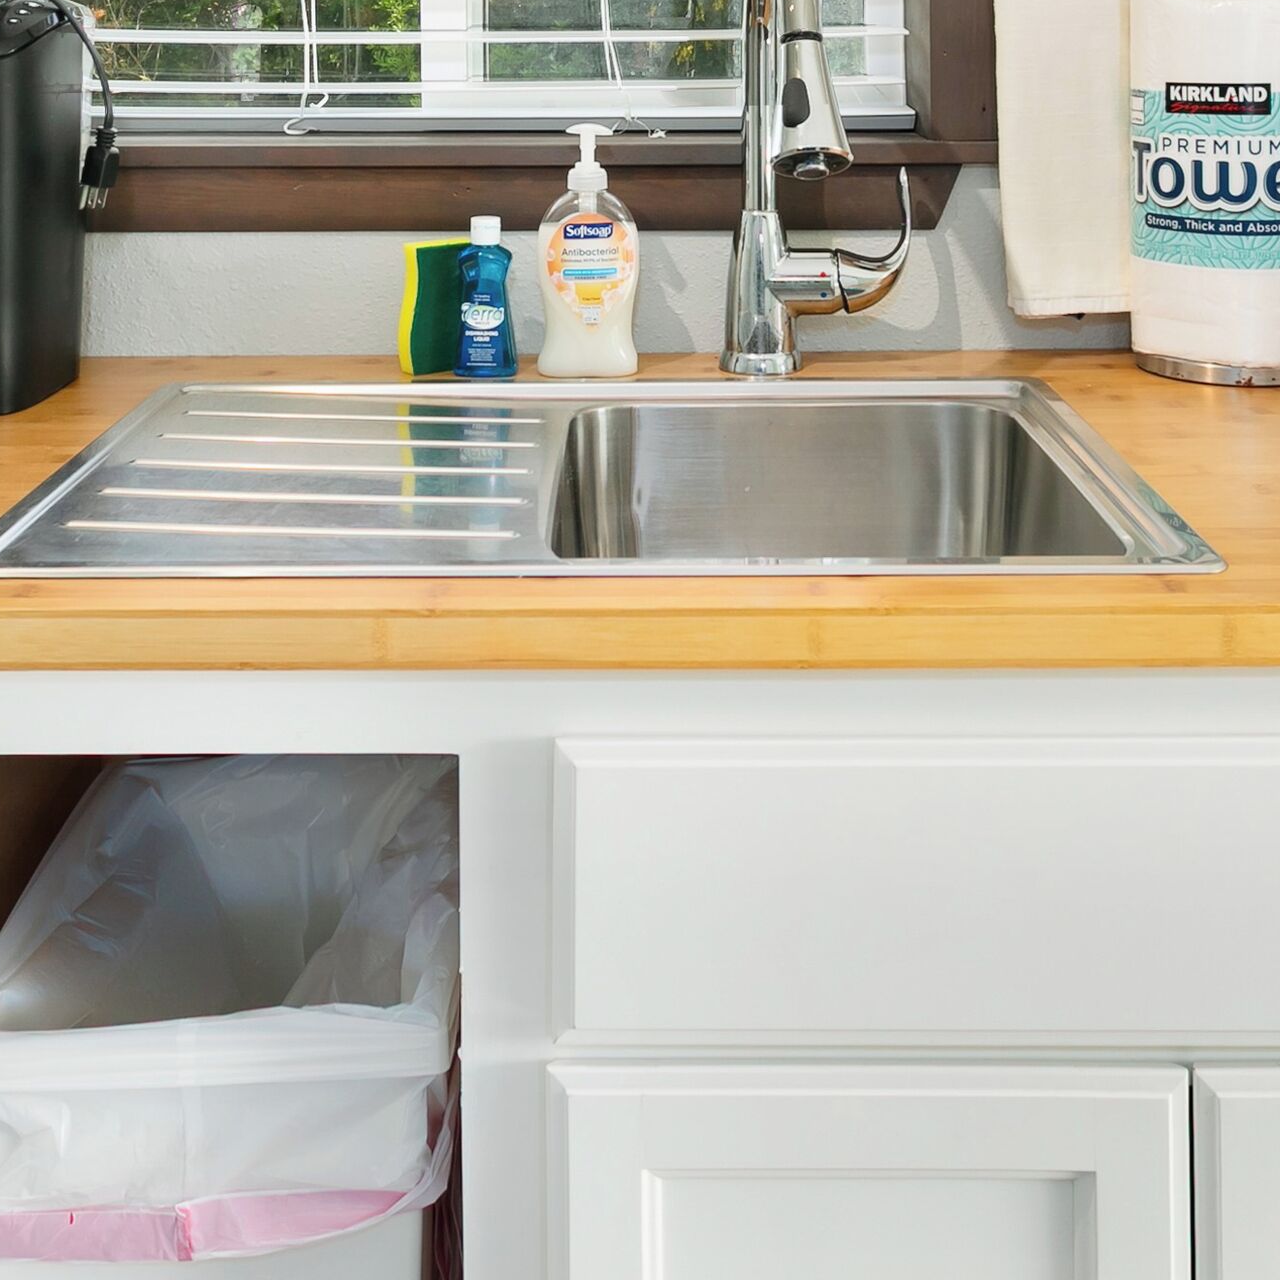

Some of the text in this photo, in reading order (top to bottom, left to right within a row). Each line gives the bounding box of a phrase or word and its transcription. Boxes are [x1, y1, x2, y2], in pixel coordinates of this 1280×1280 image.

[1169, 84, 1268, 103] KIRKLAND
[1169, 102, 1266, 114] Signature
[565, 223, 613, 239] Softsoap
[1146, 214, 1182, 230] Strong,
[1184, 219, 1216, 232] Thick
[1219, 222, 1244, 233] and
[561, 246, 620, 257] Antibacterial
